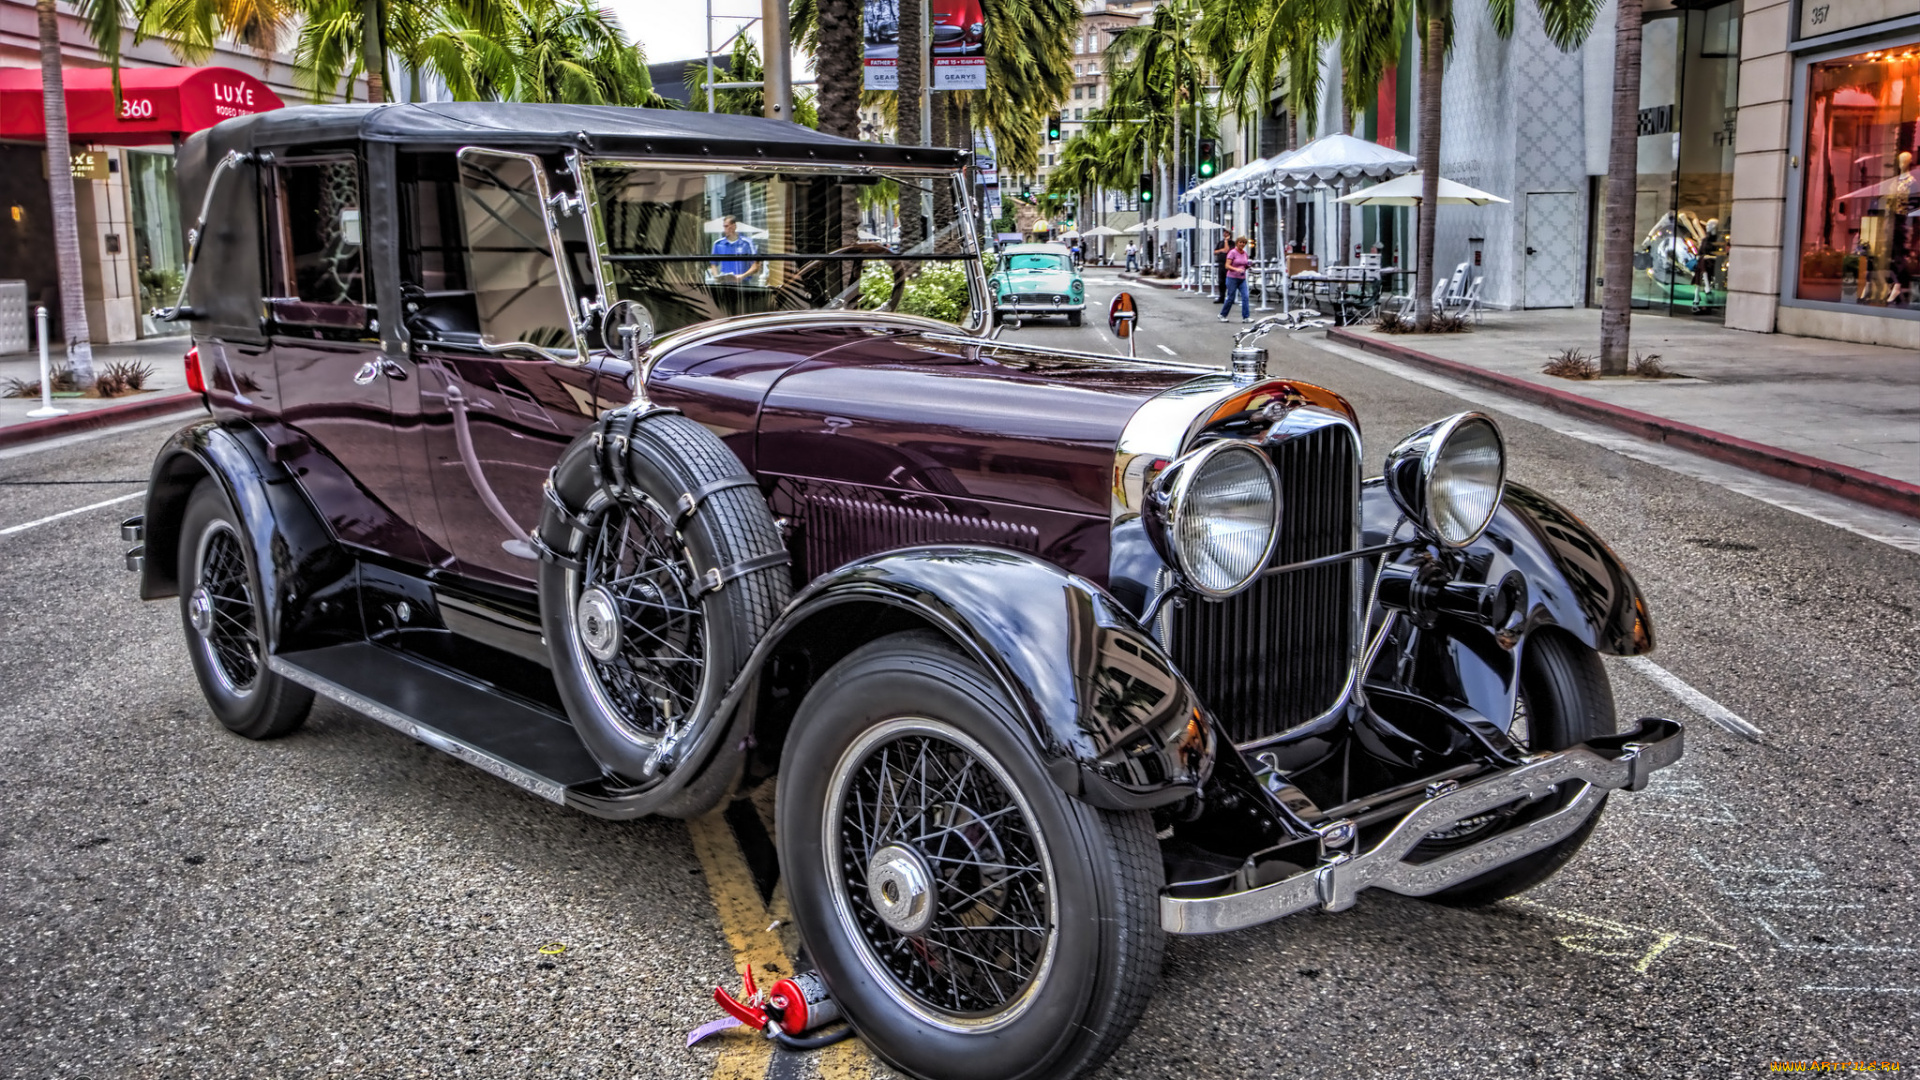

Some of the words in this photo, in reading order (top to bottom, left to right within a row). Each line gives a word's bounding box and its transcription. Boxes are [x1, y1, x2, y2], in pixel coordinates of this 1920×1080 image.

[1811, 4, 1830, 25] 357
[214, 81, 254, 105] LUXE
[121, 99, 152, 117] 360
[217, 105, 236, 116] RODEO
[1637, 104, 1674, 137] FENDI
[69, 152, 95, 165] XE
